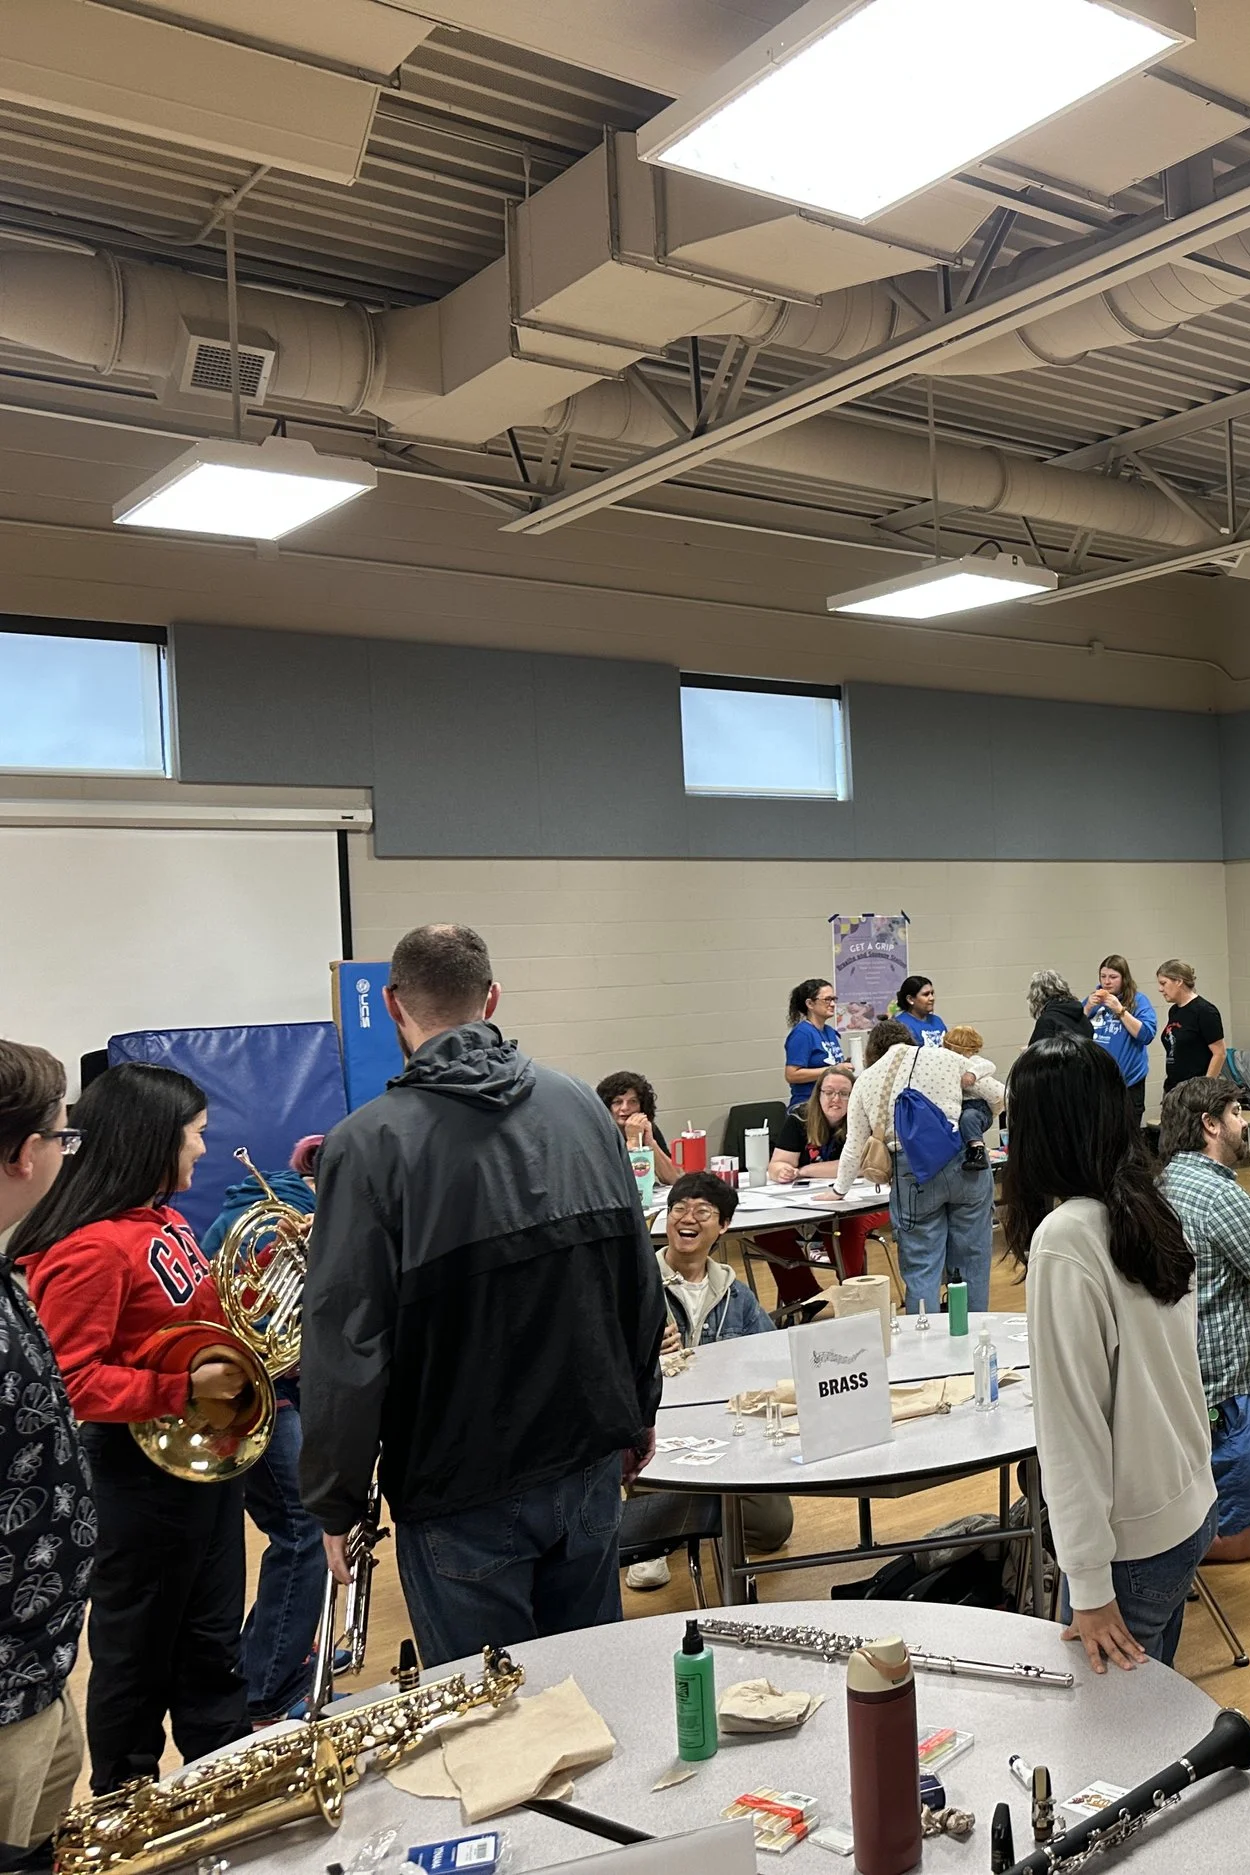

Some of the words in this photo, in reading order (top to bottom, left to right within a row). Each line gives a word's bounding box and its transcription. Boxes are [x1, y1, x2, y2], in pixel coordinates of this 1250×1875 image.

[849, 943, 865, 953] GET
[867, 942, 873, 950] A
[875, 942, 895, 952] GRIP
[360, 993, 370, 1028] UCS
[148, 1222, 210, 1307] GA
[818, 1372, 869, 1398] BRASS
